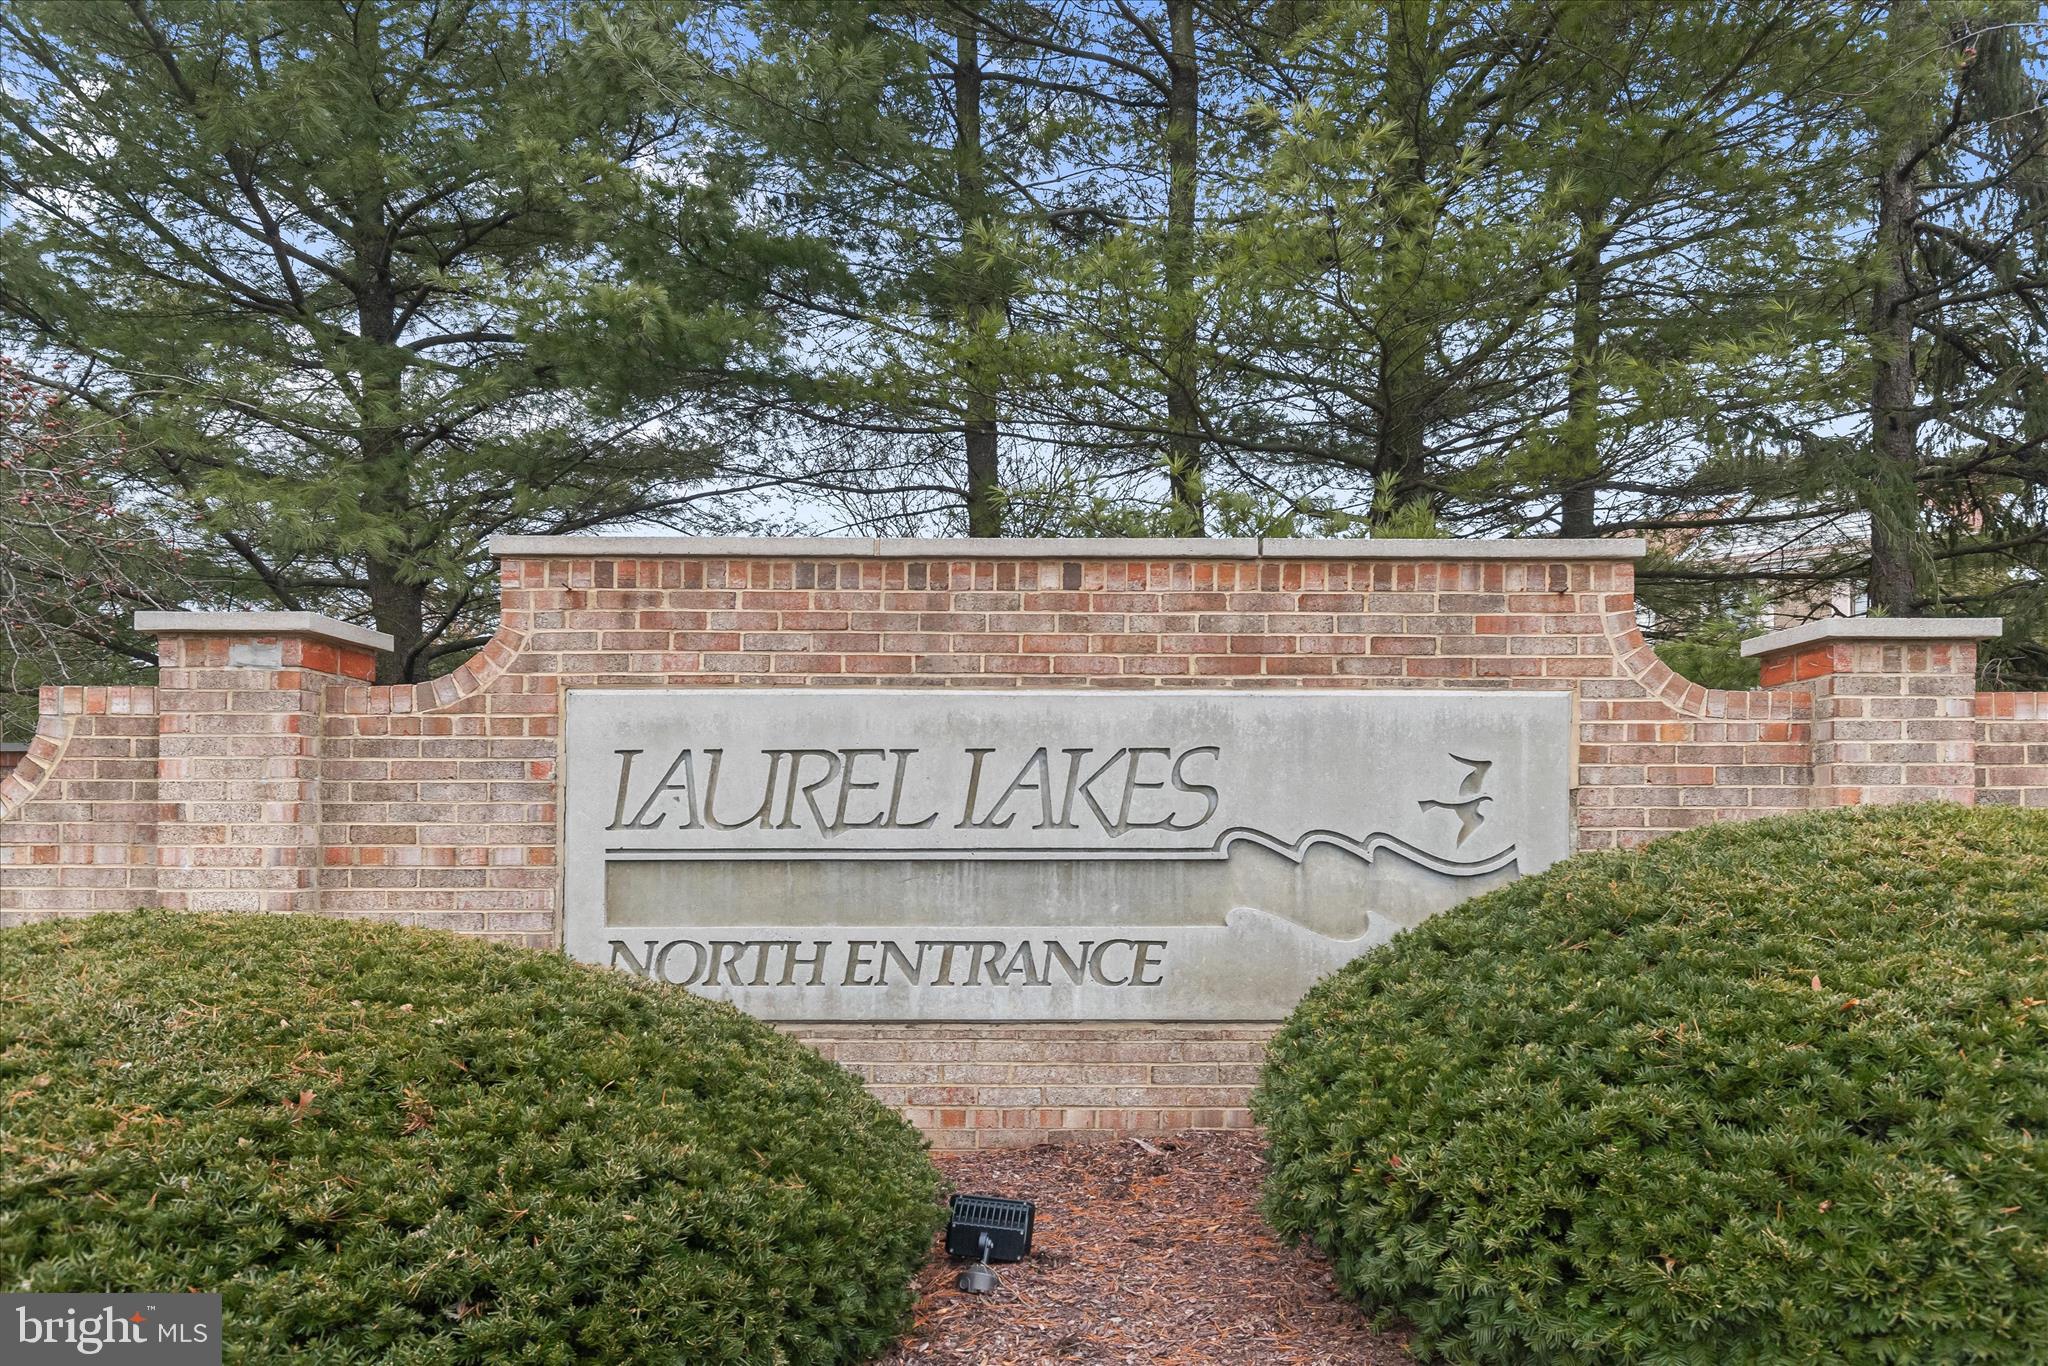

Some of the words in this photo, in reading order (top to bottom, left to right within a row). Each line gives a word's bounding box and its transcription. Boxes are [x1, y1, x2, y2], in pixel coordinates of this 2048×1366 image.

[604, 747, 940, 839] LAUREL
[954, 746, 1222, 839] LAKES
[607, 939, 833, 987] NORTH
[840, 938, 1169, 987] ENTRANCE
